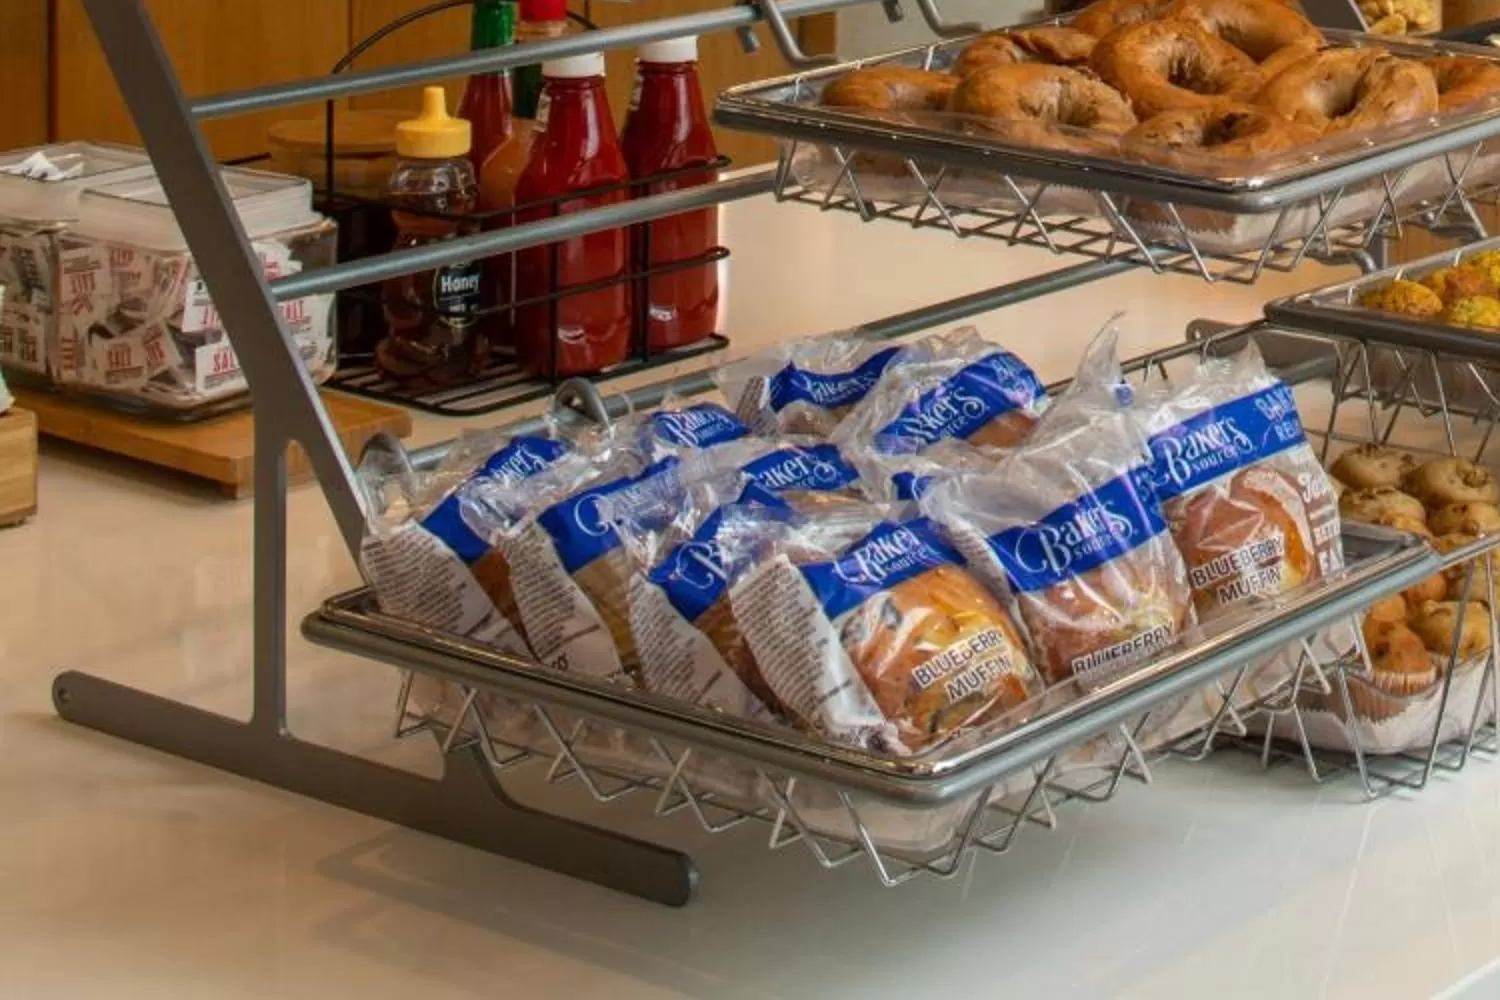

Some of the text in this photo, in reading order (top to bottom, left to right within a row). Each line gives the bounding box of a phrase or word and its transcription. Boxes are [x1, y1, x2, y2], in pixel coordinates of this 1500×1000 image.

[441, 275, 479, 294] Honey
[213, 351, 237, 372] SAL
[1218, 569, 1281, 605] MUFFIN
[947, 655, 1012, 701] MUFFIN
